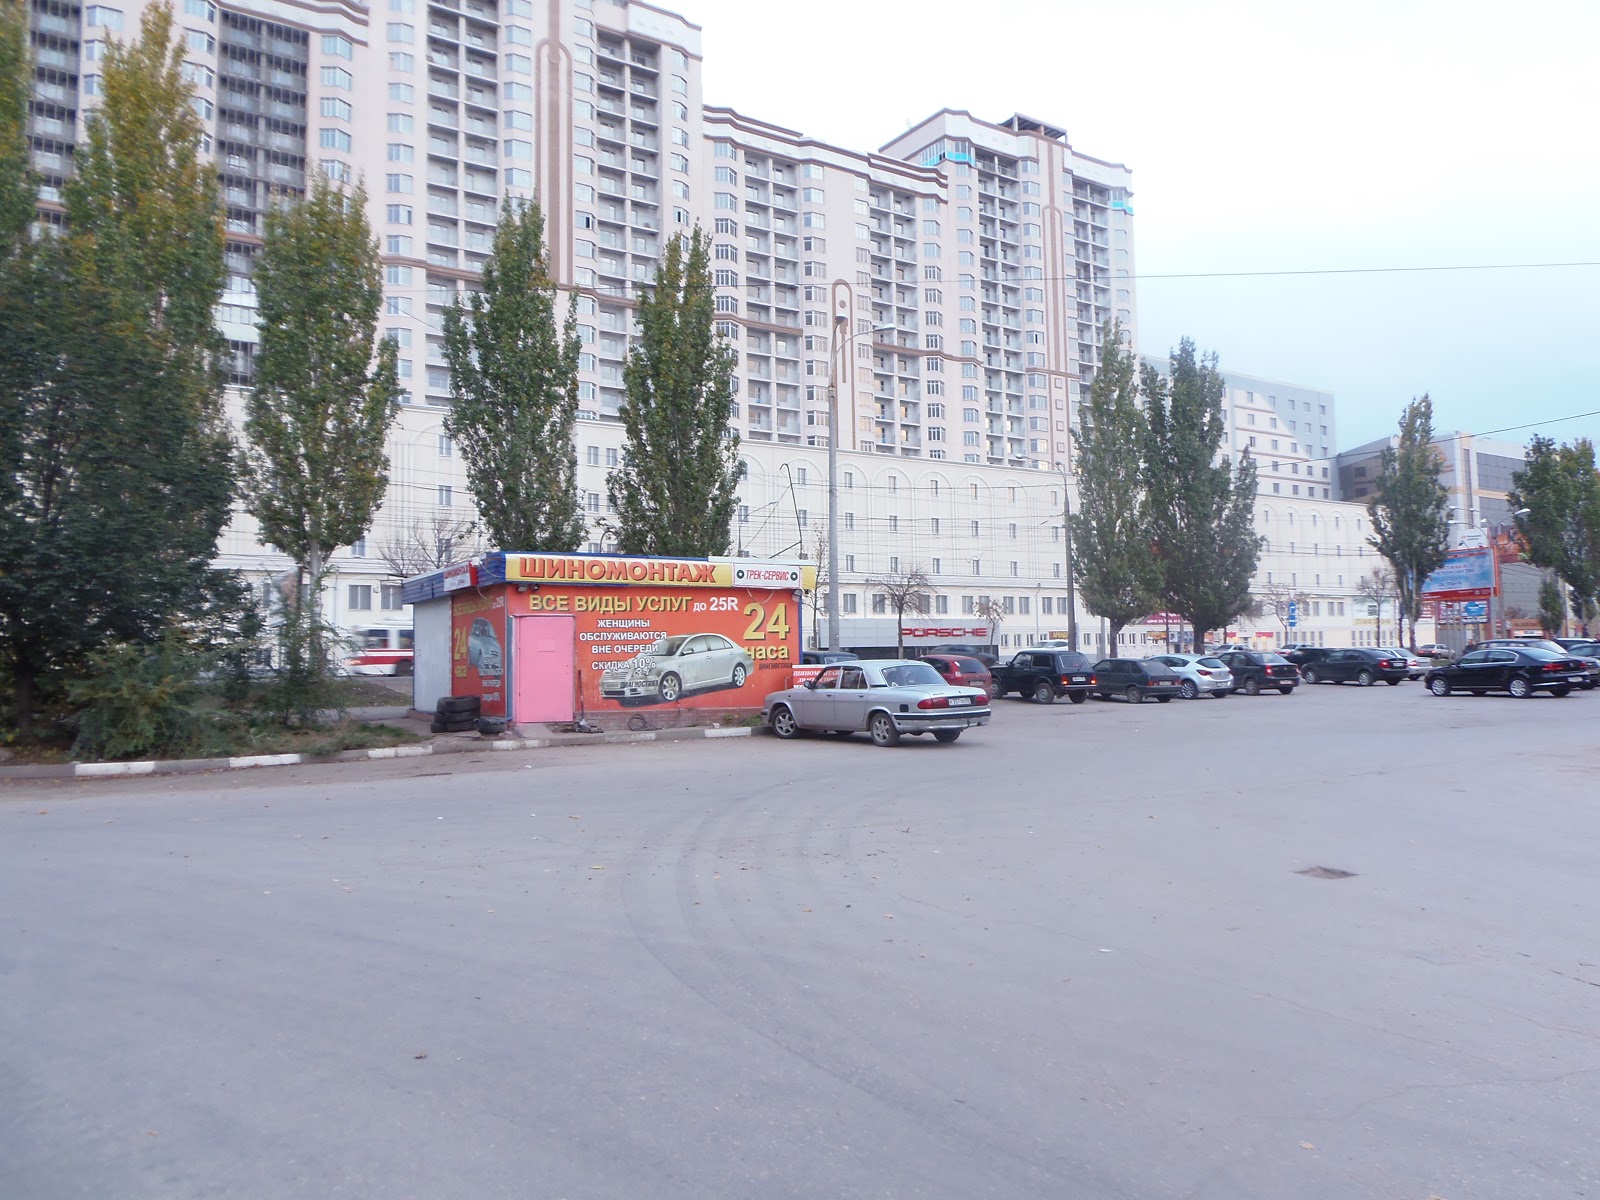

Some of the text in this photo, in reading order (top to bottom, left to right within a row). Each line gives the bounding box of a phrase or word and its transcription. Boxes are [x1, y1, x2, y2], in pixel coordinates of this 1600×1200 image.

[520, 557, 717, 583] ШИНОМОНТАЖ
[745, 569, 790, 581] ТРЕК-СЕРВИС
[529, 594, 739, 614] ВСЕ ВИДЫ УСЛУГ до 25R
[597, 619, 650, 629] ЖЕНЩИНЫ
[743, 602, 790, 640] 24
[579, 631, 667, 641] ОБСЛУЖИВАЮТСЯ
[901, 627, 987, 638] PORSCHE
[591, 644, 659, 654] ВНЕ ОЧЕРЕДИ
[744, 644, 790, 660] часа
[591, 656, 656, 670] СКИДКА 10%
